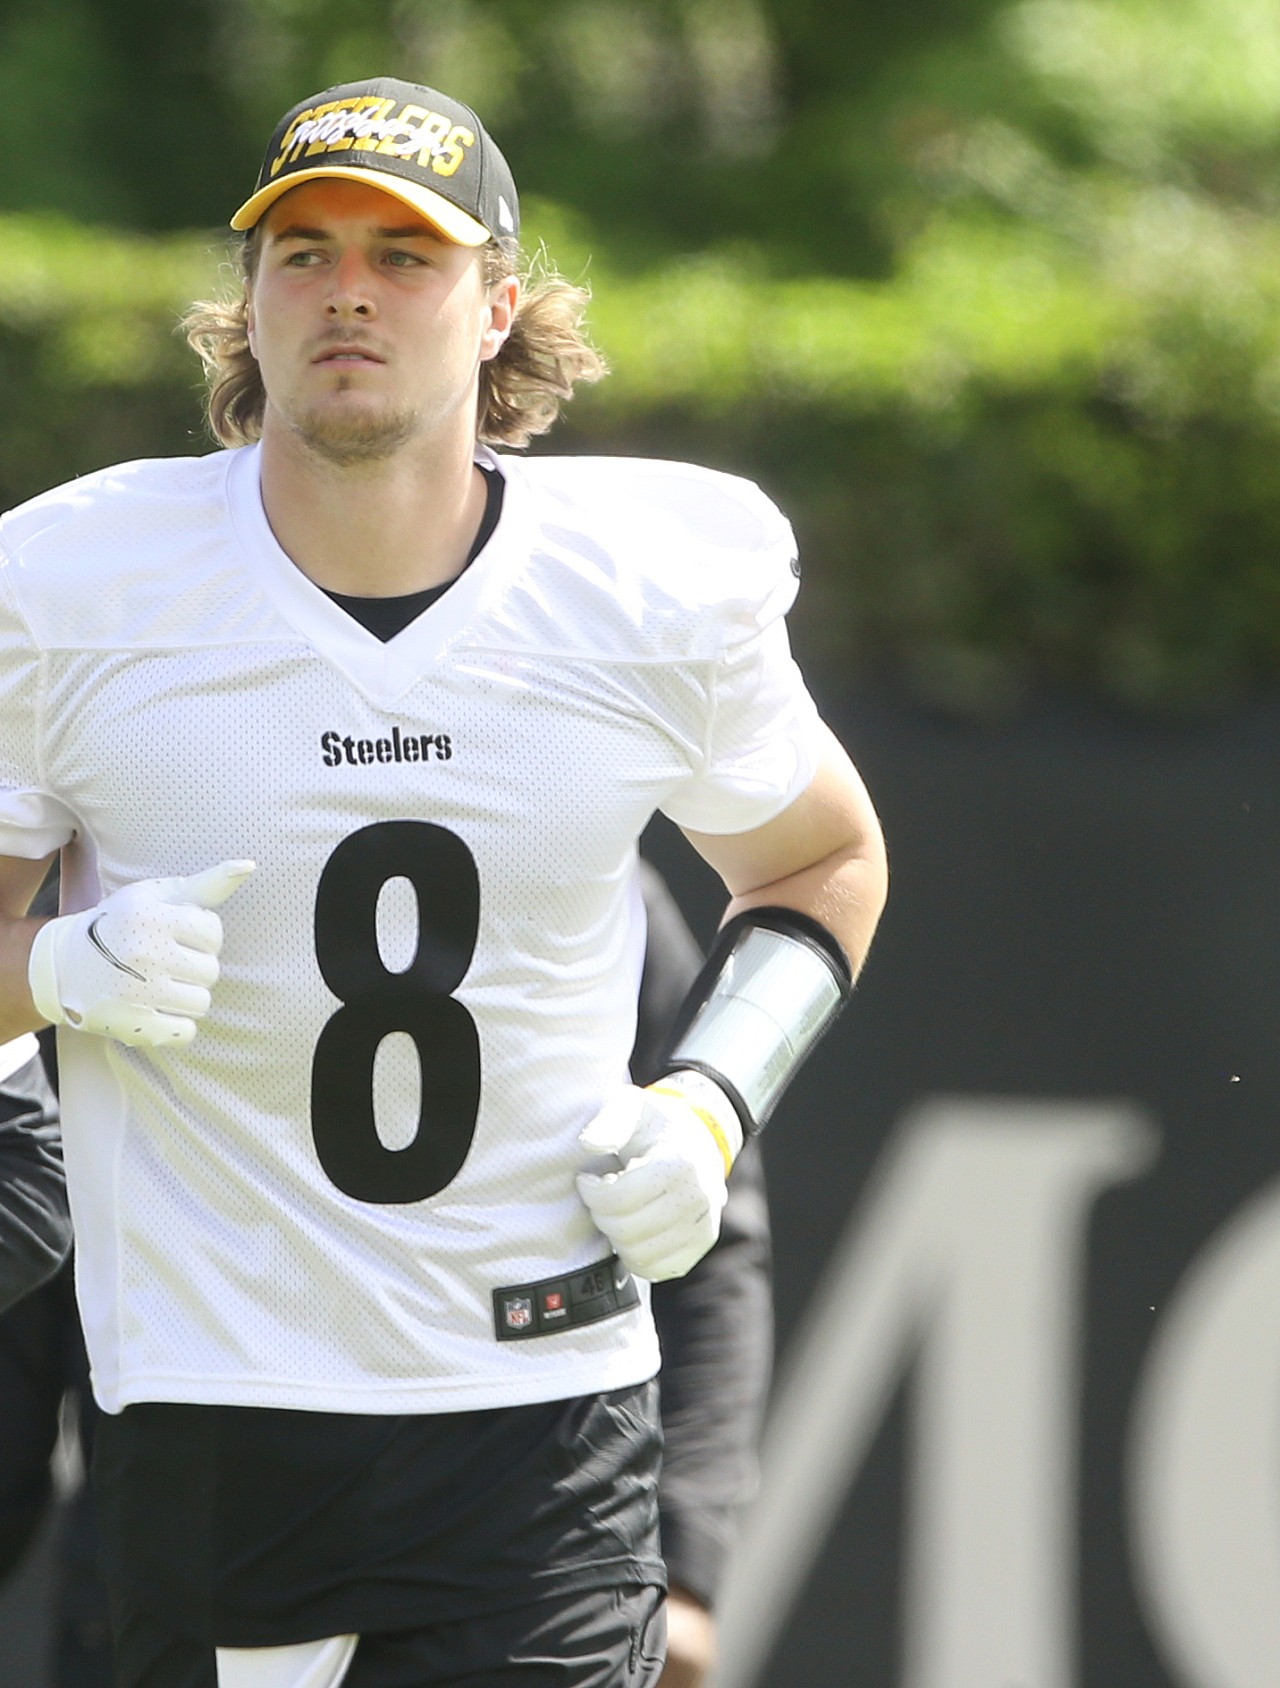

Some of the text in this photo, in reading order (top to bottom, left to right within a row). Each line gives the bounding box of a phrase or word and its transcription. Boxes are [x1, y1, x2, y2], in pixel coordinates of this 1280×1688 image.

[271, 96, 475, 178] STEELERS
[321, 727, 453, 767] Steelers
[311, 819, 482, 1205] 8
